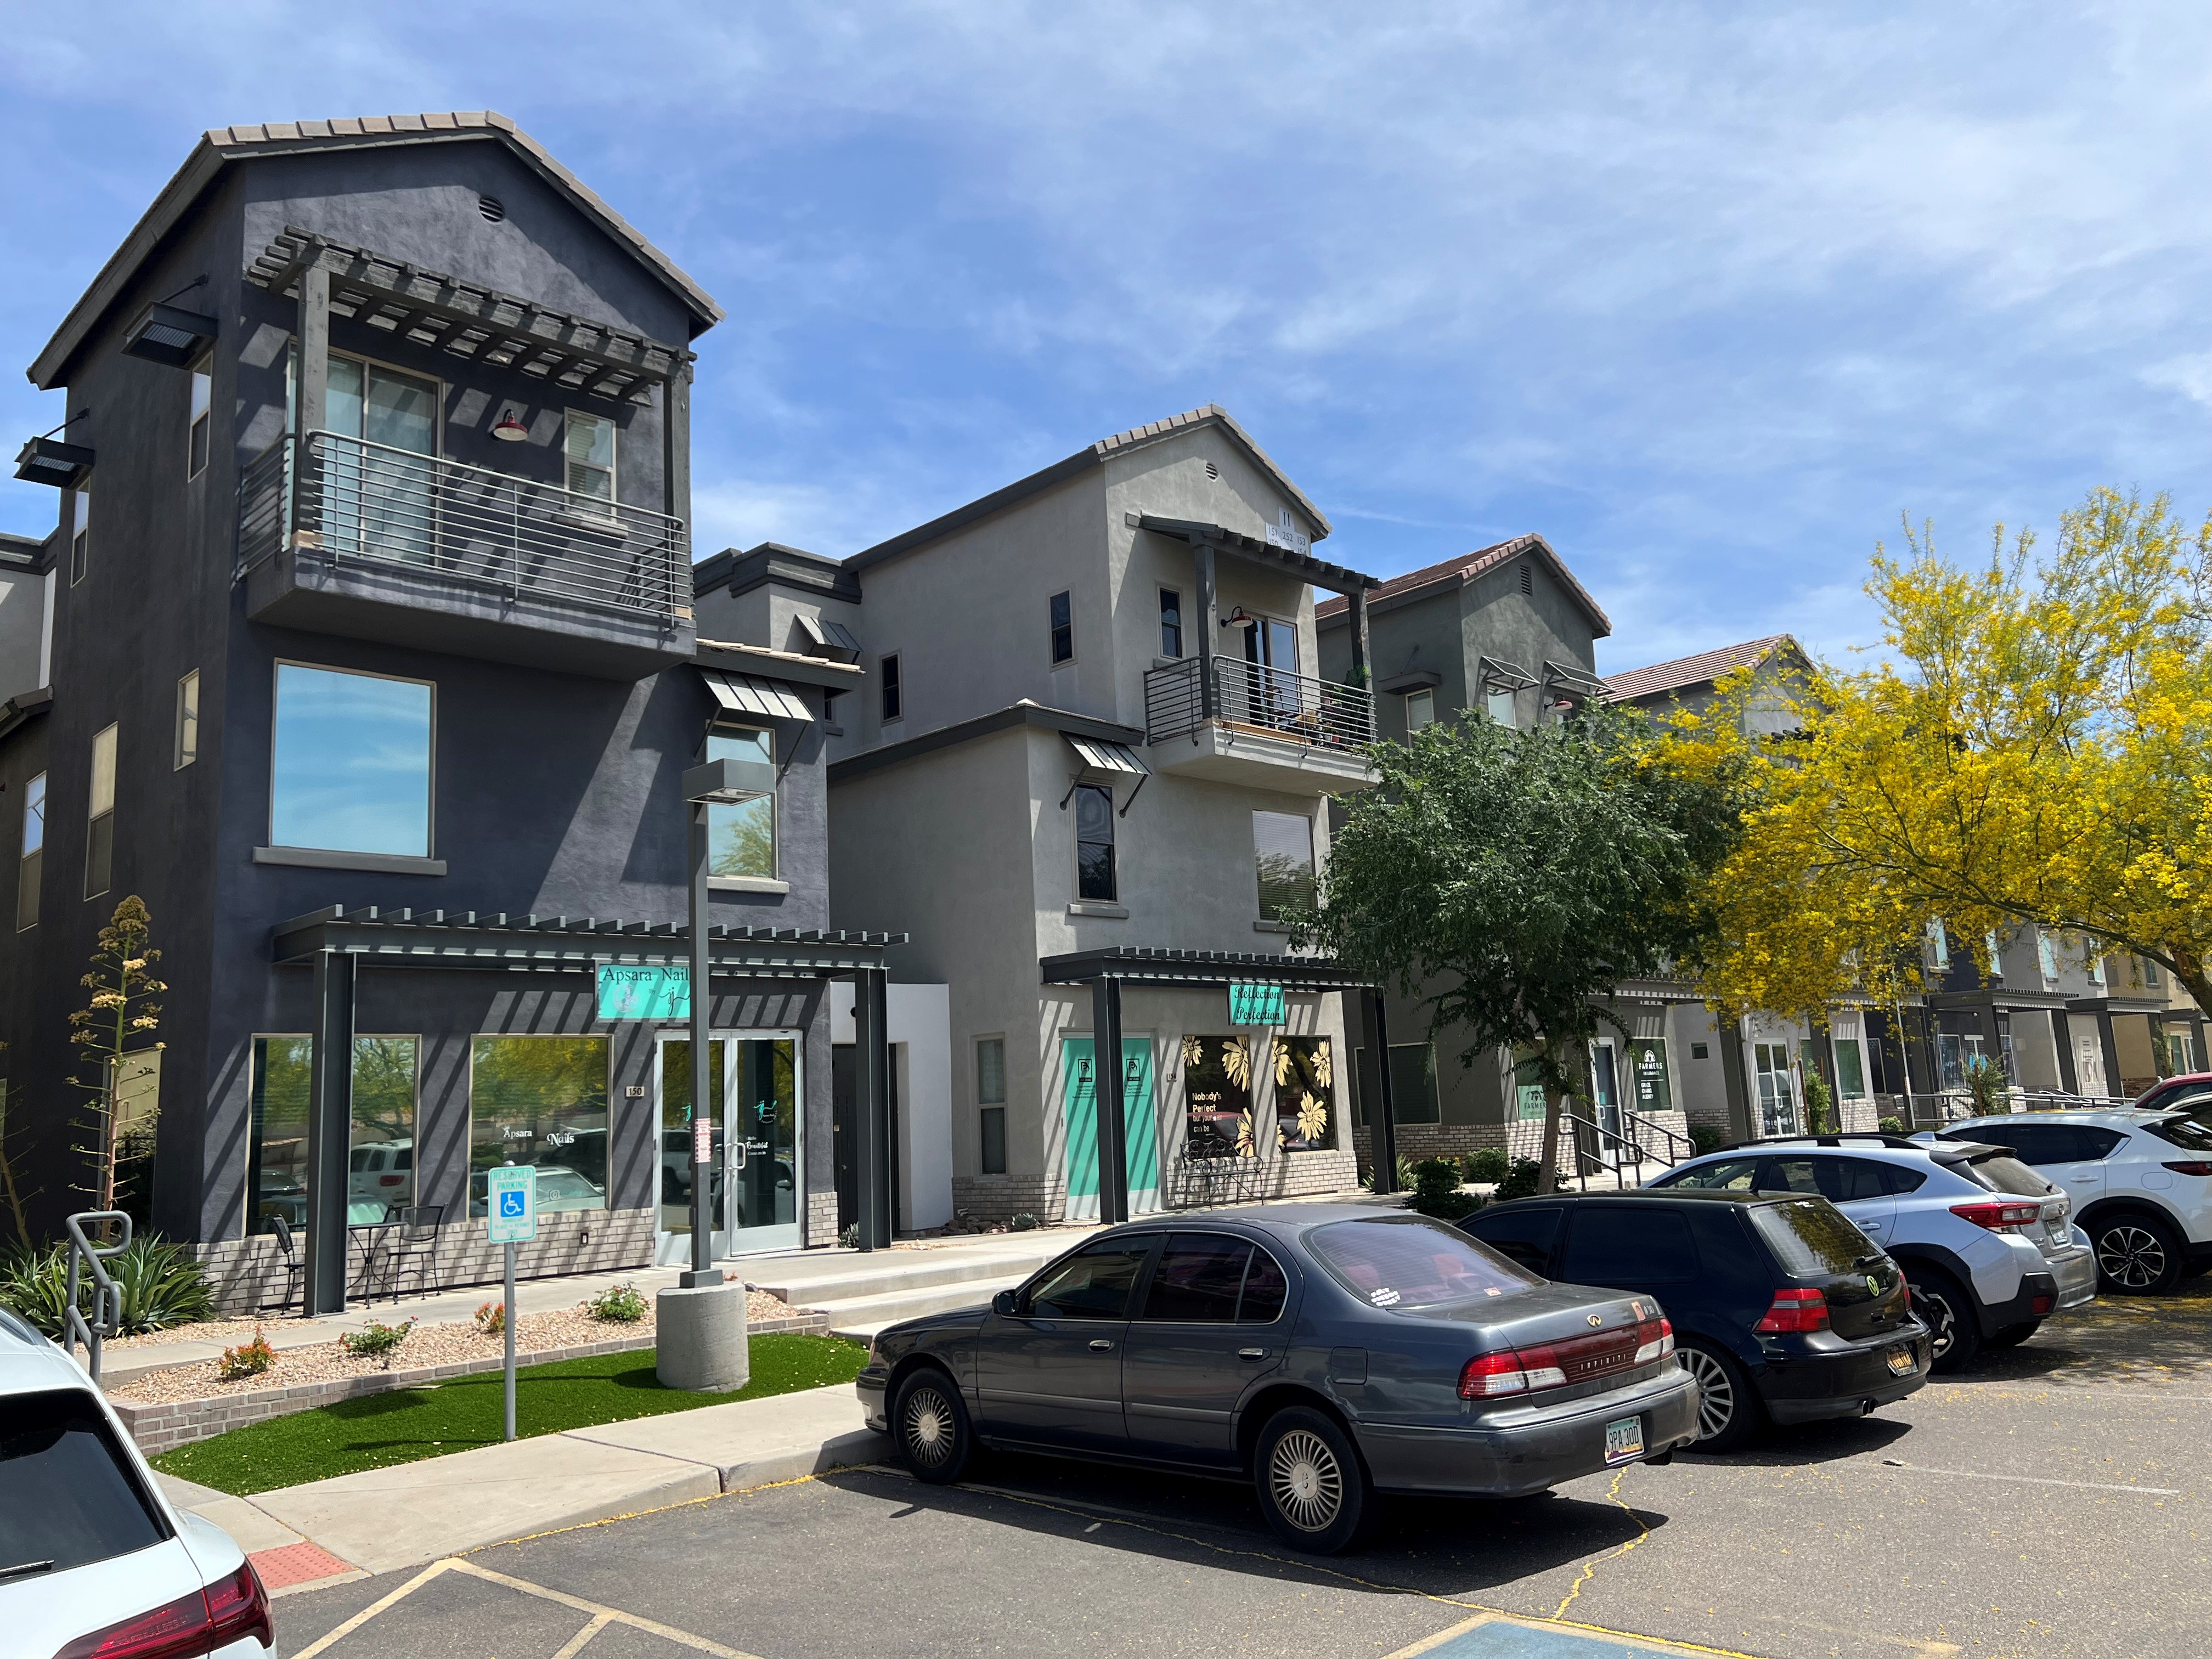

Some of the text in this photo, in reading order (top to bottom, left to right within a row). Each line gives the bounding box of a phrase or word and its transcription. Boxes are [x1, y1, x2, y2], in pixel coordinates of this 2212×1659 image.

[1268, 525, 1306, 546] 151 252 153
[603, 967, 690, 985] Apsara Nail
[1234, 985, 1280, 1003] Reflection
[1236, 1006, 1280, 1023] Perfection
[1638, 1062, 1663, 1070] FARMERS
[629, 1087, 642, 1096] 150
[1192, 1091, 1222, 1102] Nobody's
[1192, 1103, 1216, 1113] Perfect
[504, 1128, 575, 1147] Apsara Nails
[493, 1170, 532, 1180] RESERVED
[497, 1180, 528, 1191] PARKING
[1581, 1353, 1626, 1370] INFINITI
[1609, 1430, 1623, 1451] 9PA
